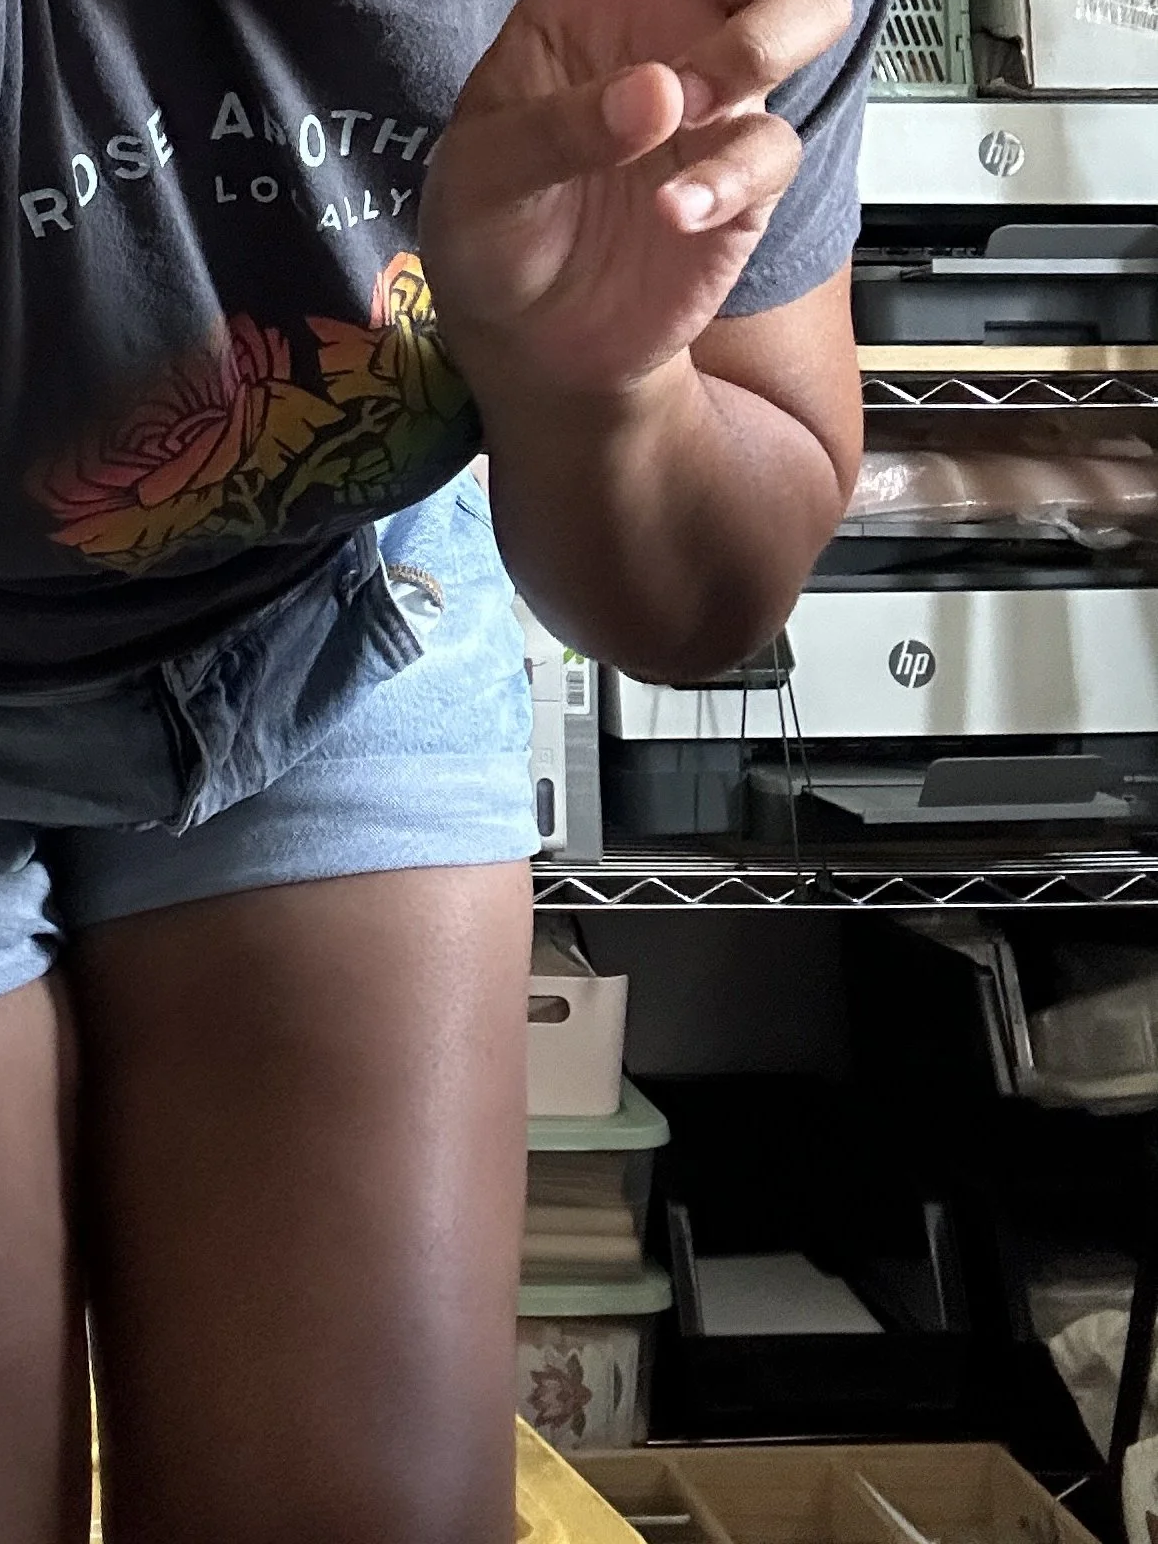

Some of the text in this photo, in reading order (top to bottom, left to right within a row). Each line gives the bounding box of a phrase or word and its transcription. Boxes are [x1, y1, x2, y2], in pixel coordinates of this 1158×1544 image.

[19, 106, 175, 238] ROSE
[983, 130, 1022, 177] hp
[214, 175, 413, 231] LOALLY
[893, 639, 932, 688] hp
